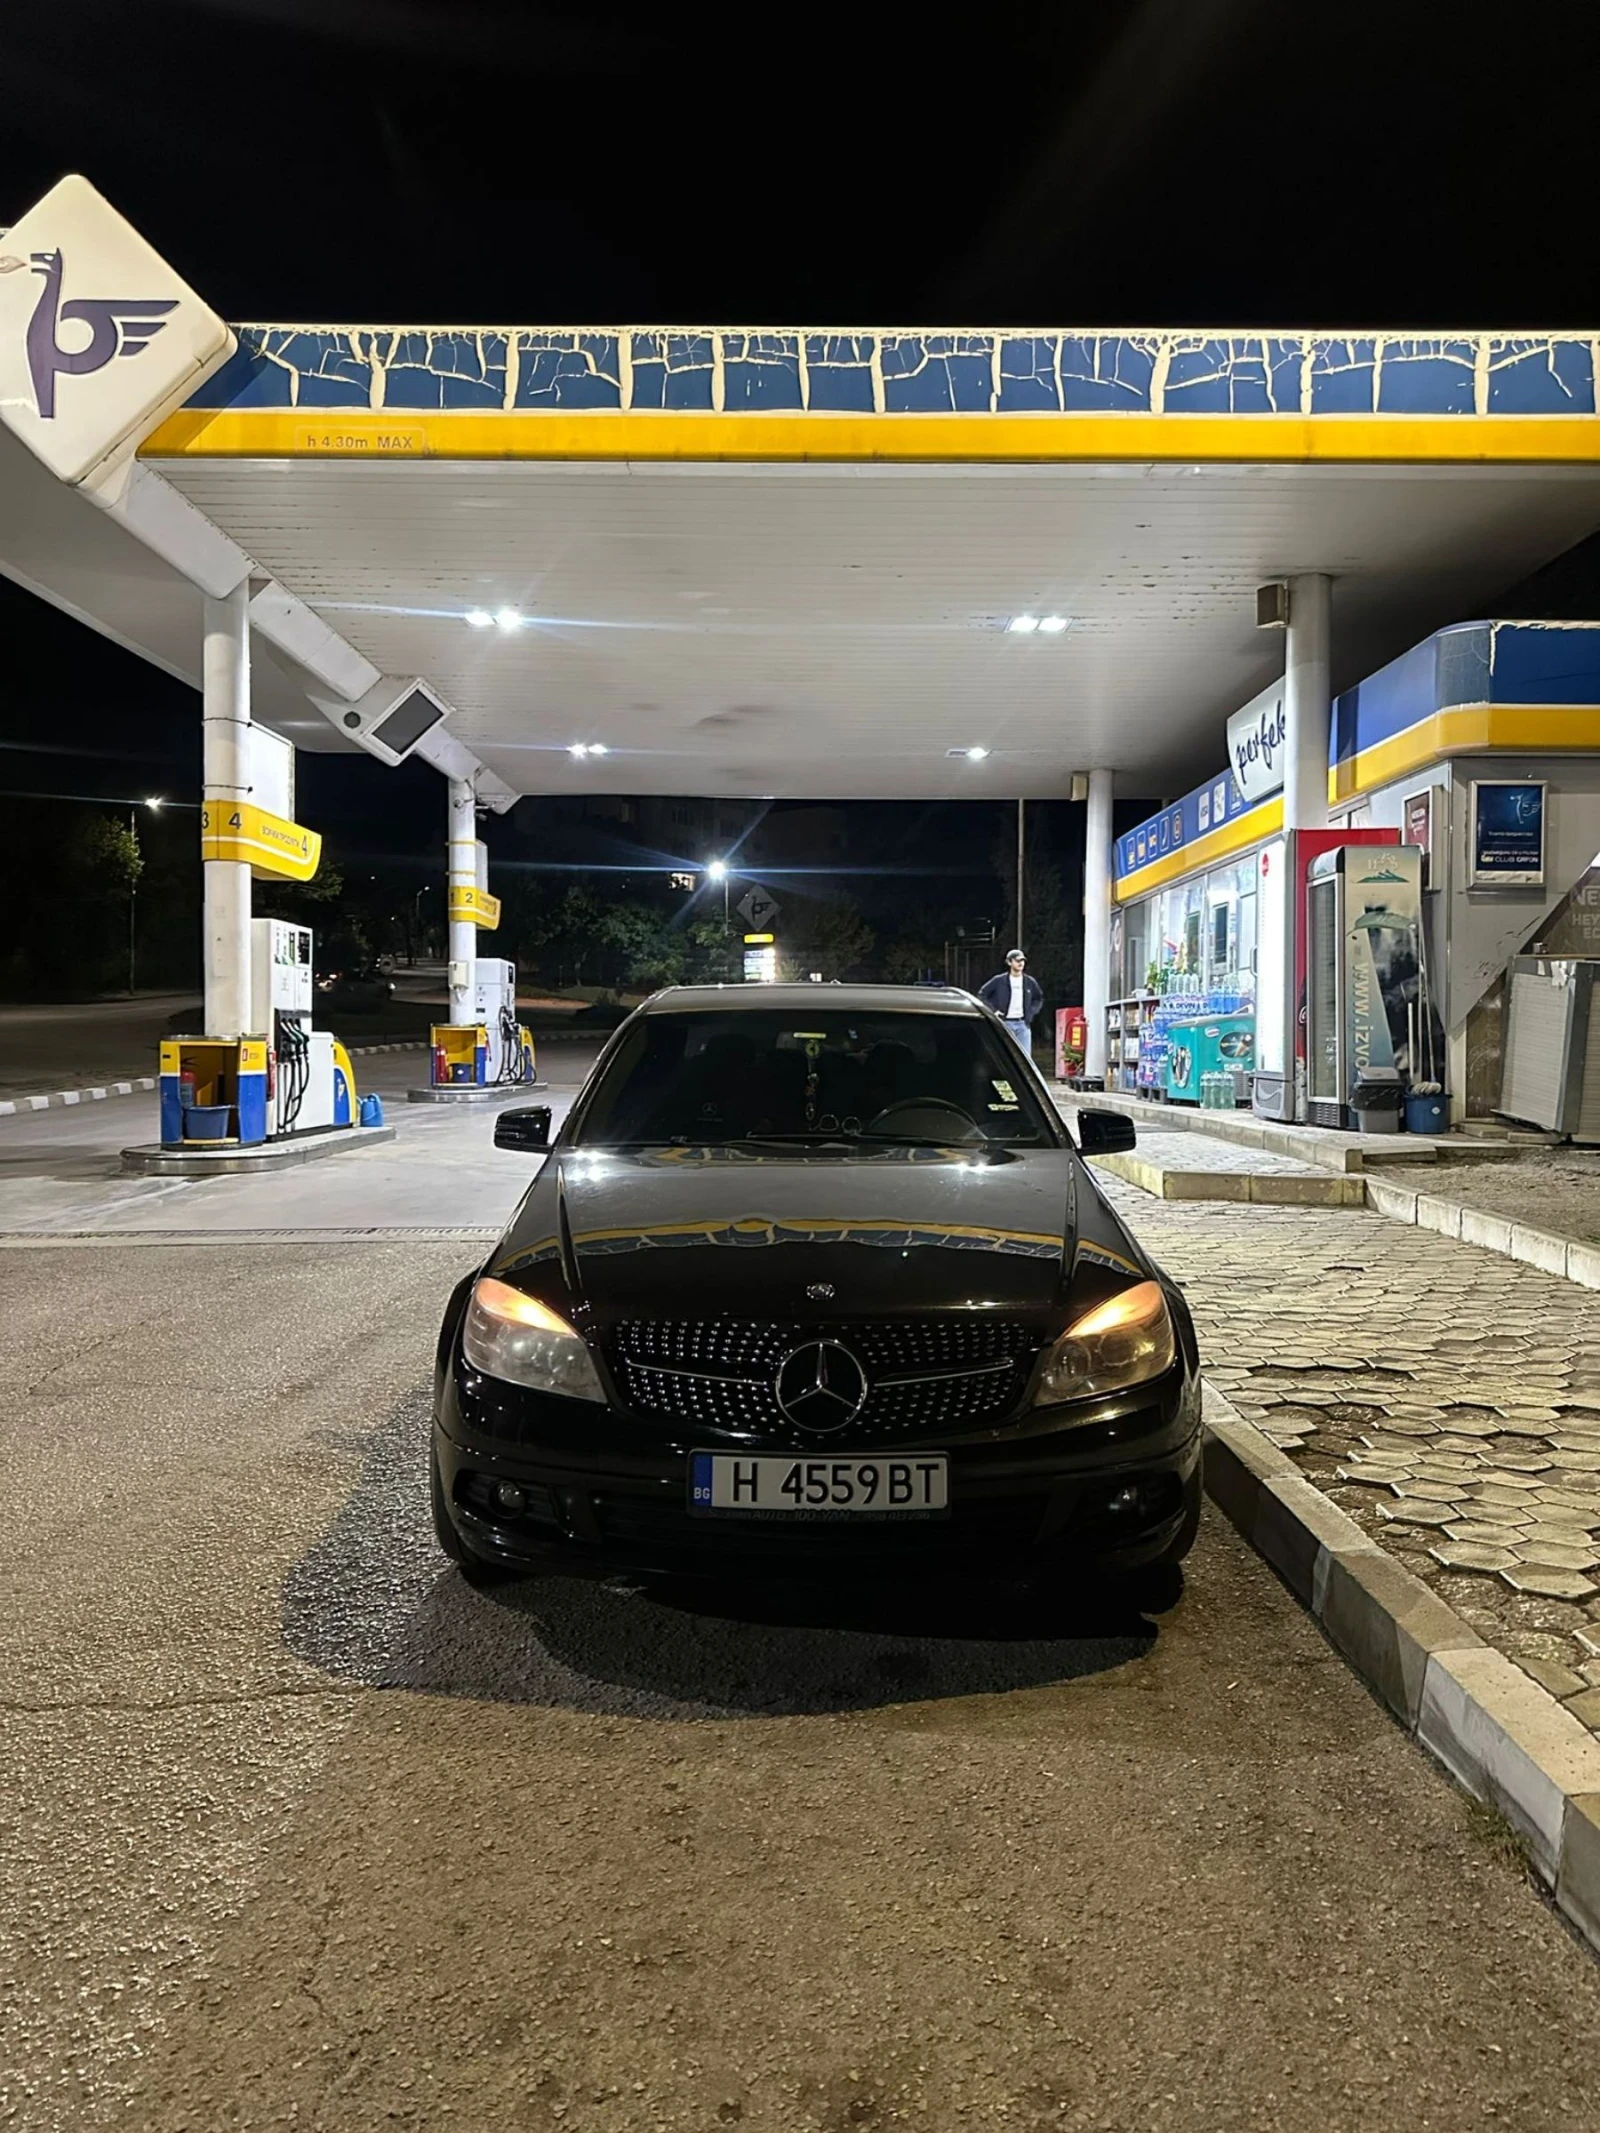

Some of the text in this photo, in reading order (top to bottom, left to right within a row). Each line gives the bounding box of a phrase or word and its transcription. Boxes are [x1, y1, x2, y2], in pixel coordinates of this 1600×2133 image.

[307, 435, 413, 448] h 4.30m MAX
[229, 812, 242, 830] 4
[301, 834, 308, 857] 4
[465, 892, 473, 904] 2
[732, 1462, 759, 1503] H
[693, 1487, 710, 1499] BG
